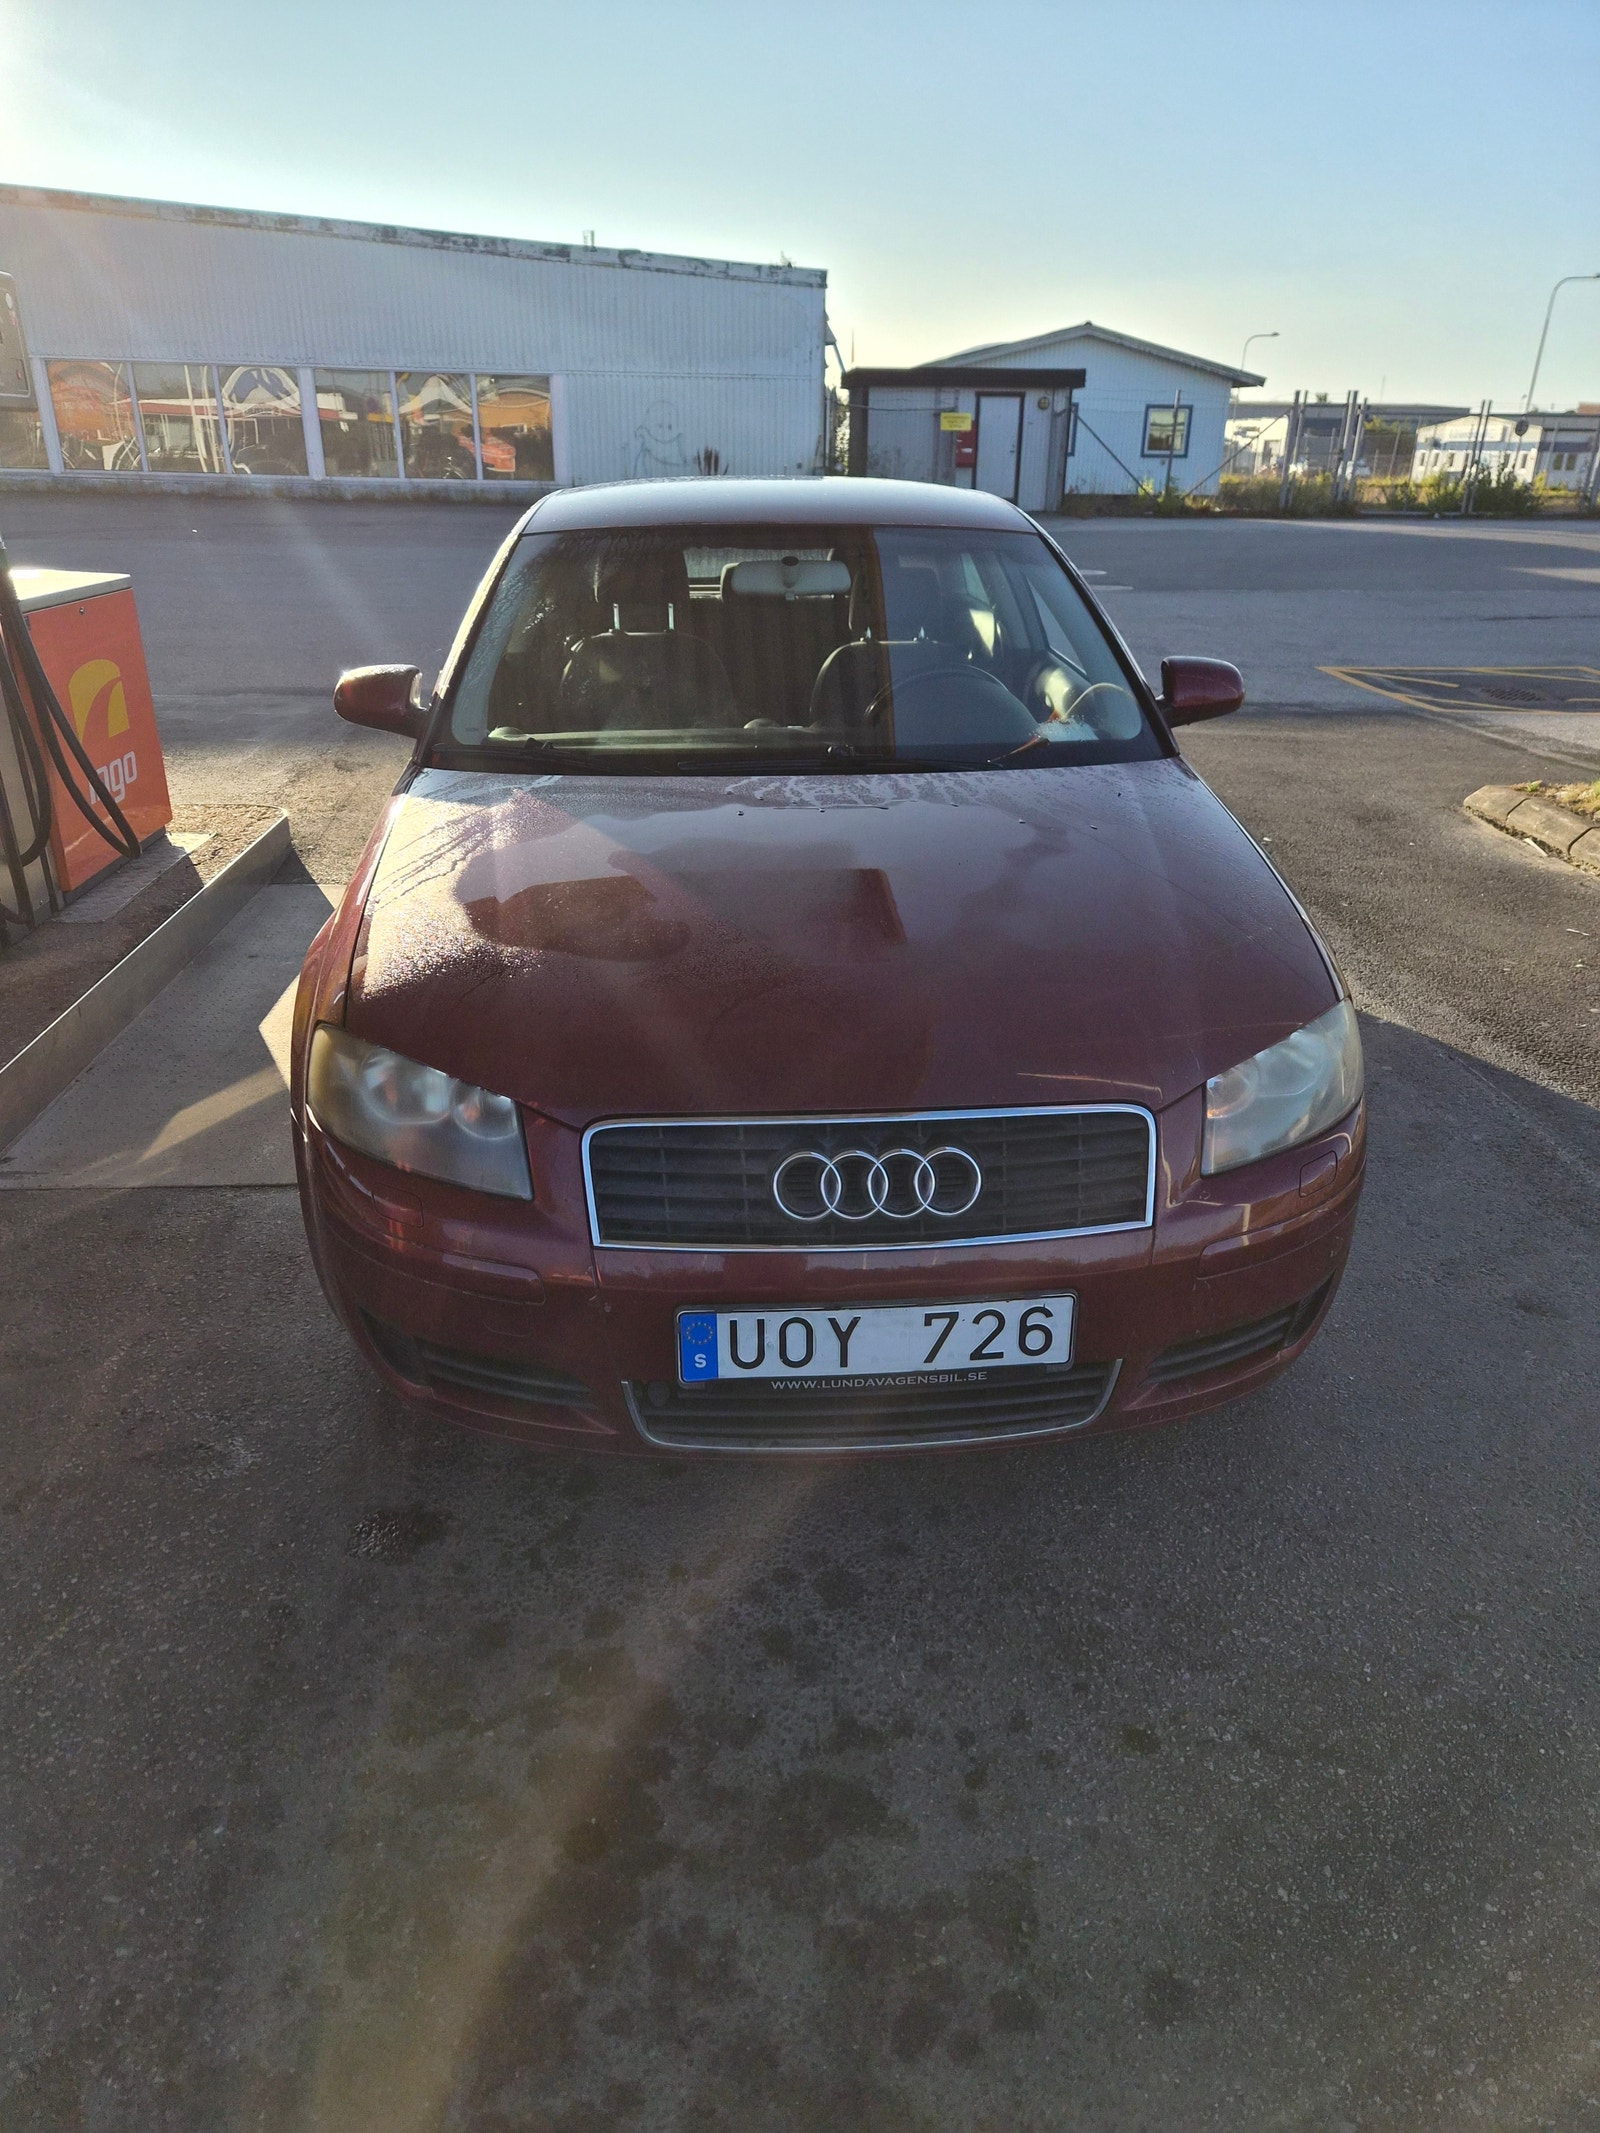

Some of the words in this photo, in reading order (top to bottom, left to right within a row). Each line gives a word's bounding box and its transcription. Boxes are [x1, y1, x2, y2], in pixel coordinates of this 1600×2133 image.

[729, 1315, 862, 1370] UOY
[923, 1305, 1055, 1364] 726
[694, 1353, 707, 1369] S
[771, 1371, 988, 1389] WWW.LUNDAVAGENSBIL.SE
